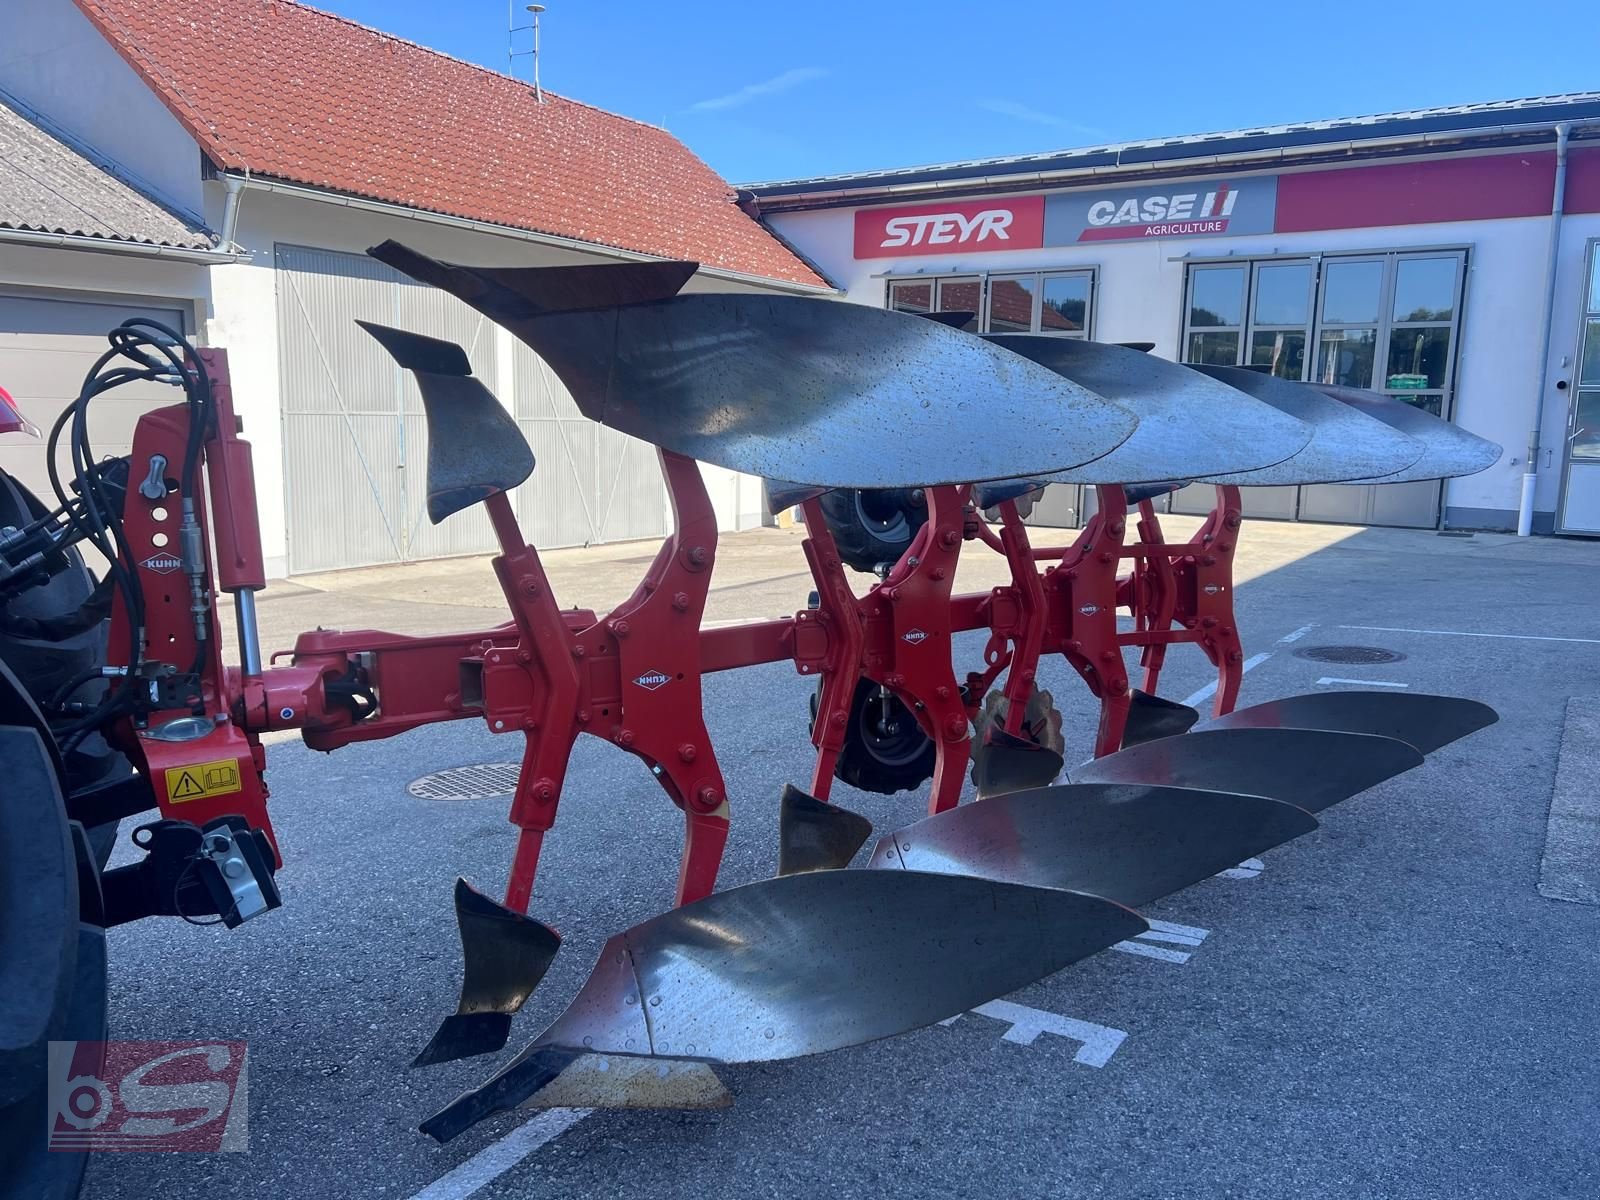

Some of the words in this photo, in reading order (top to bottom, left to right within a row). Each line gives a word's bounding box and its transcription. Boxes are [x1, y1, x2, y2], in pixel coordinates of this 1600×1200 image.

[1087, 194, 1198, 226] CASE
[880, 209, 1014, 248] STEYR
[1144, 221, 1222, 236] AGRICULTURE
[147, 559, 181, 568] KUHN
[639, 675, 666, 684] KUHN
